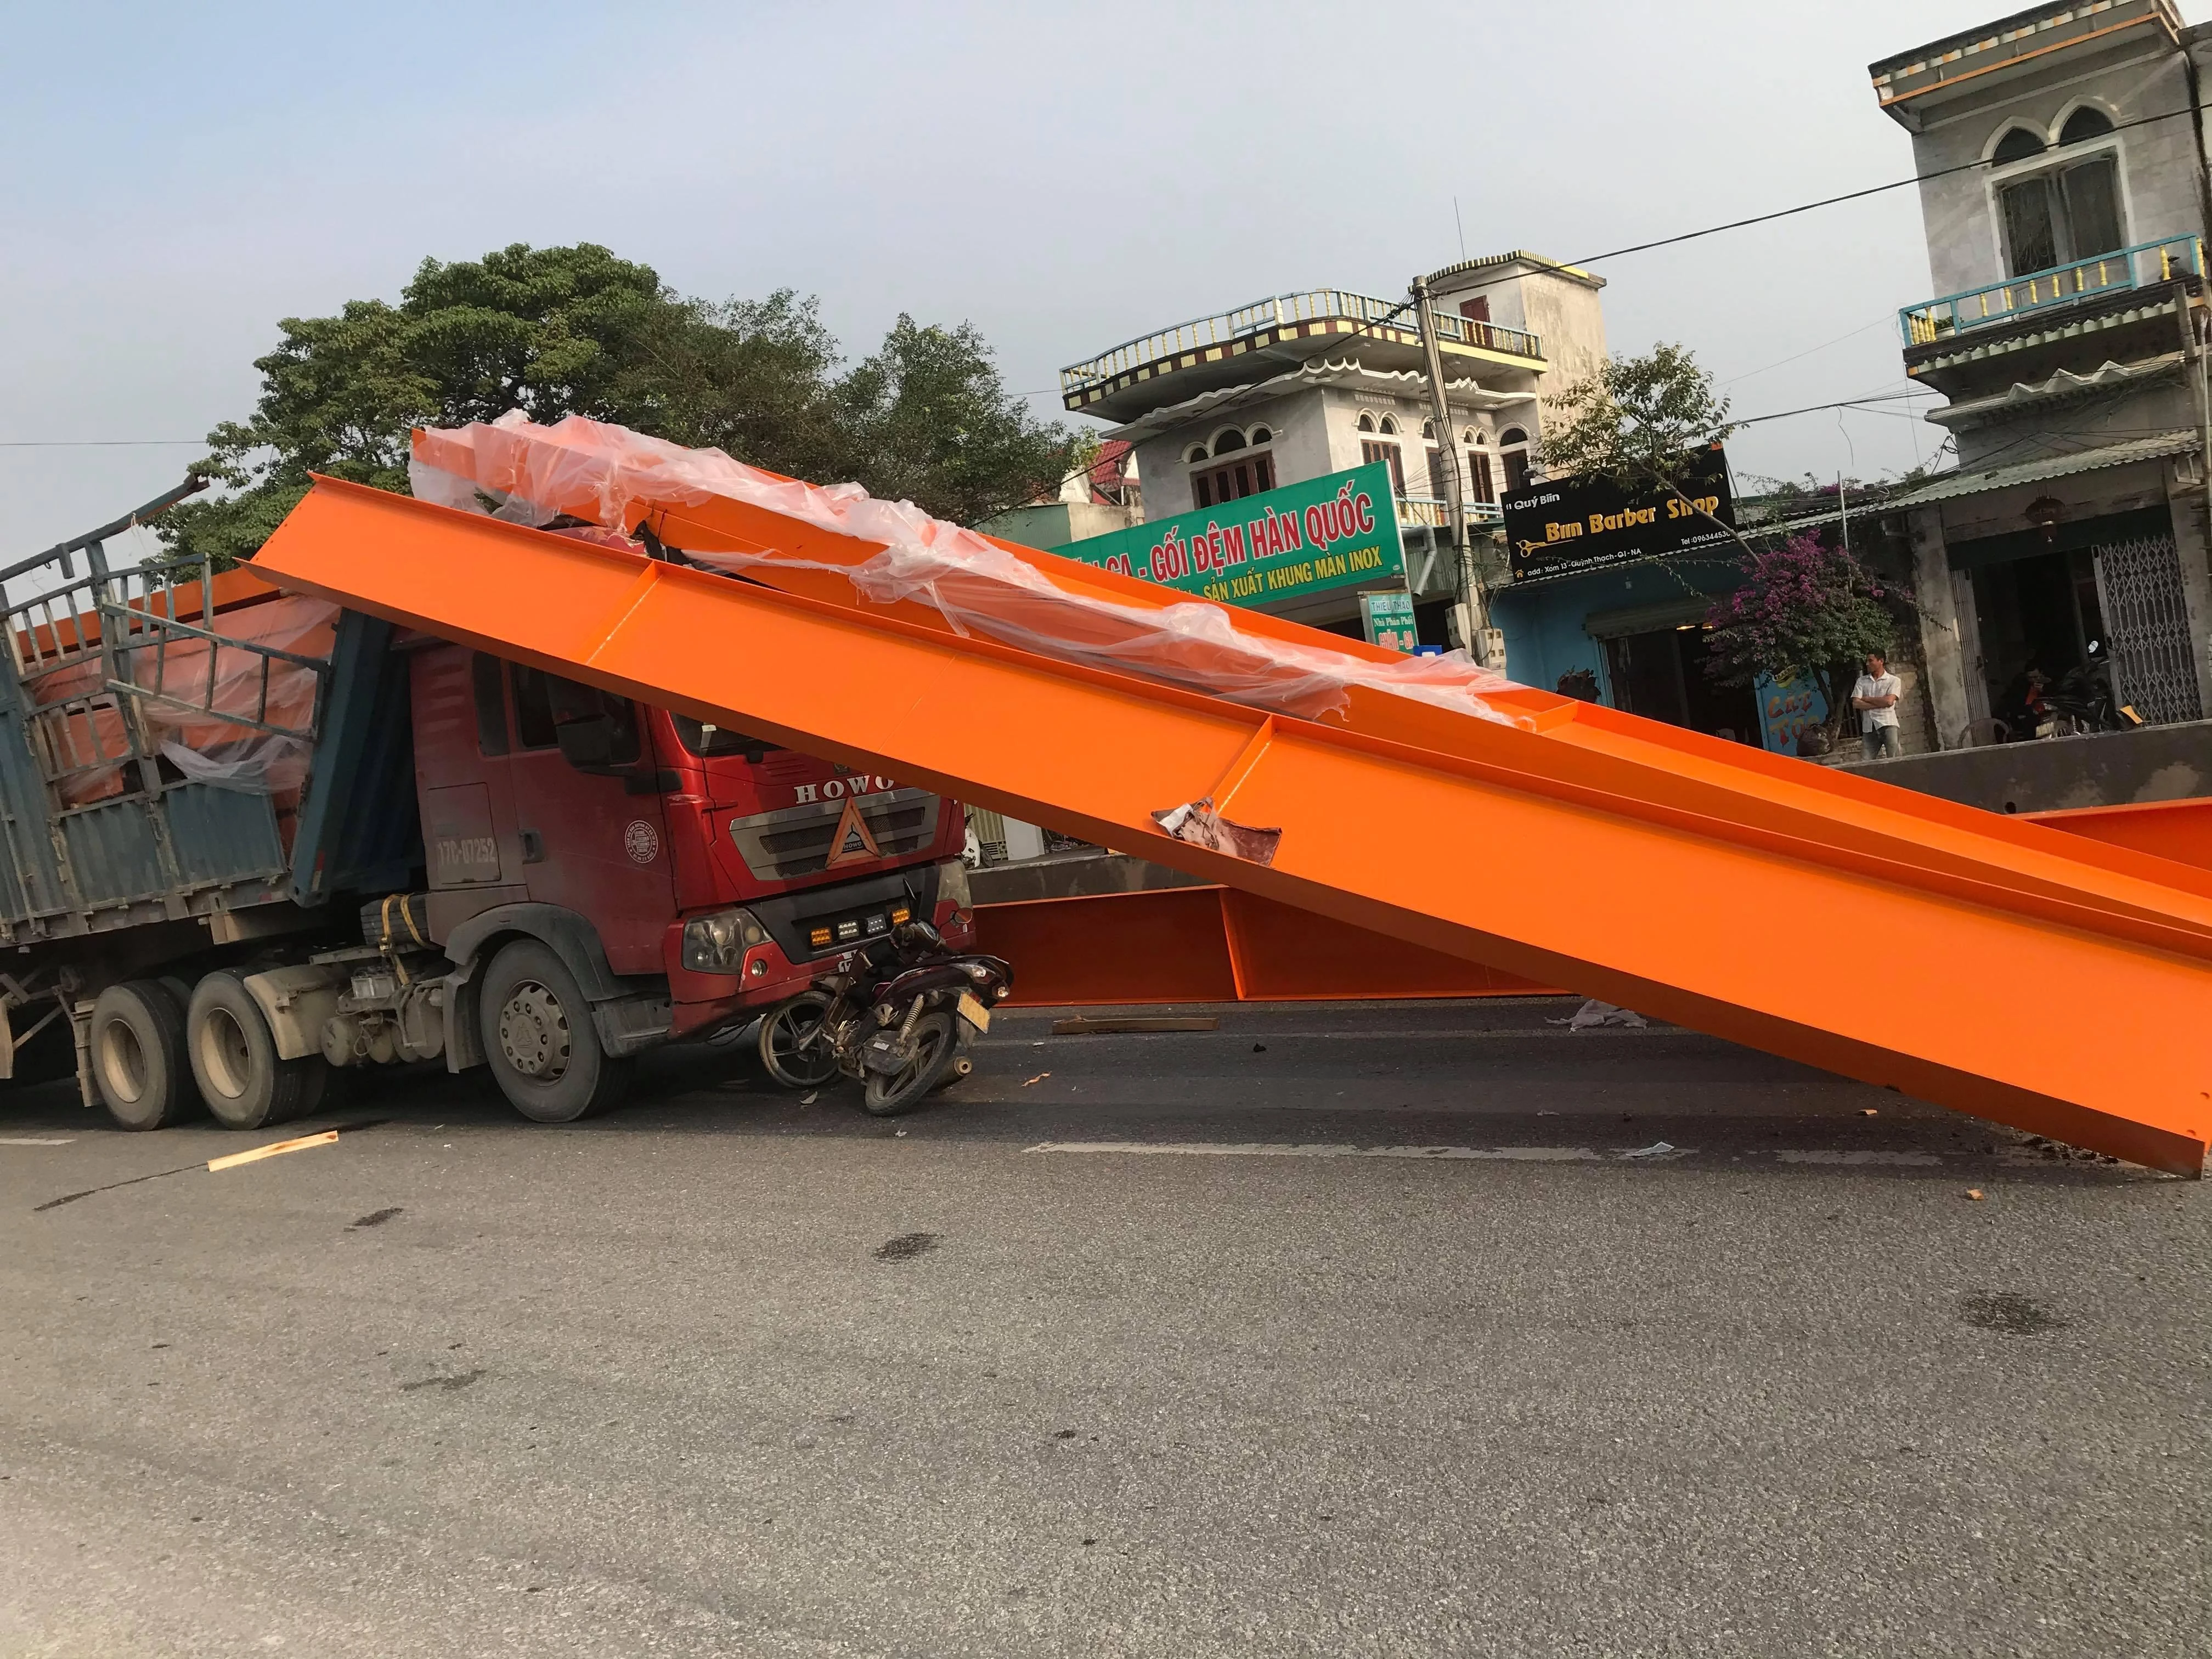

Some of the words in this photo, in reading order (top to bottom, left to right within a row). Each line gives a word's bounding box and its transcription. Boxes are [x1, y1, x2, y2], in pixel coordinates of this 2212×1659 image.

[1514, 495, 1538, 510] Quý
[1589, 506, 1656, 534] Barber
[1666, 496, 1719, 519] Shop
[1150, 525, 1190, 583] GỐI
[1191, 520, 1247, 577] ĐỆM
[1248, 505, 1302, 560] HÀN
[1305, 478, 1375, 552] QUỐC
[1203, 576, 1229, 602] SẢN
[1232, 566, 1263, 599] XUẤT
[1267, 562, 1313, 590] KHUNG
[1314, 551, 1347, 580] MÀN
[1348, 545, 1383, 572] INOX
[794, 775, 894, 804] HOWO
